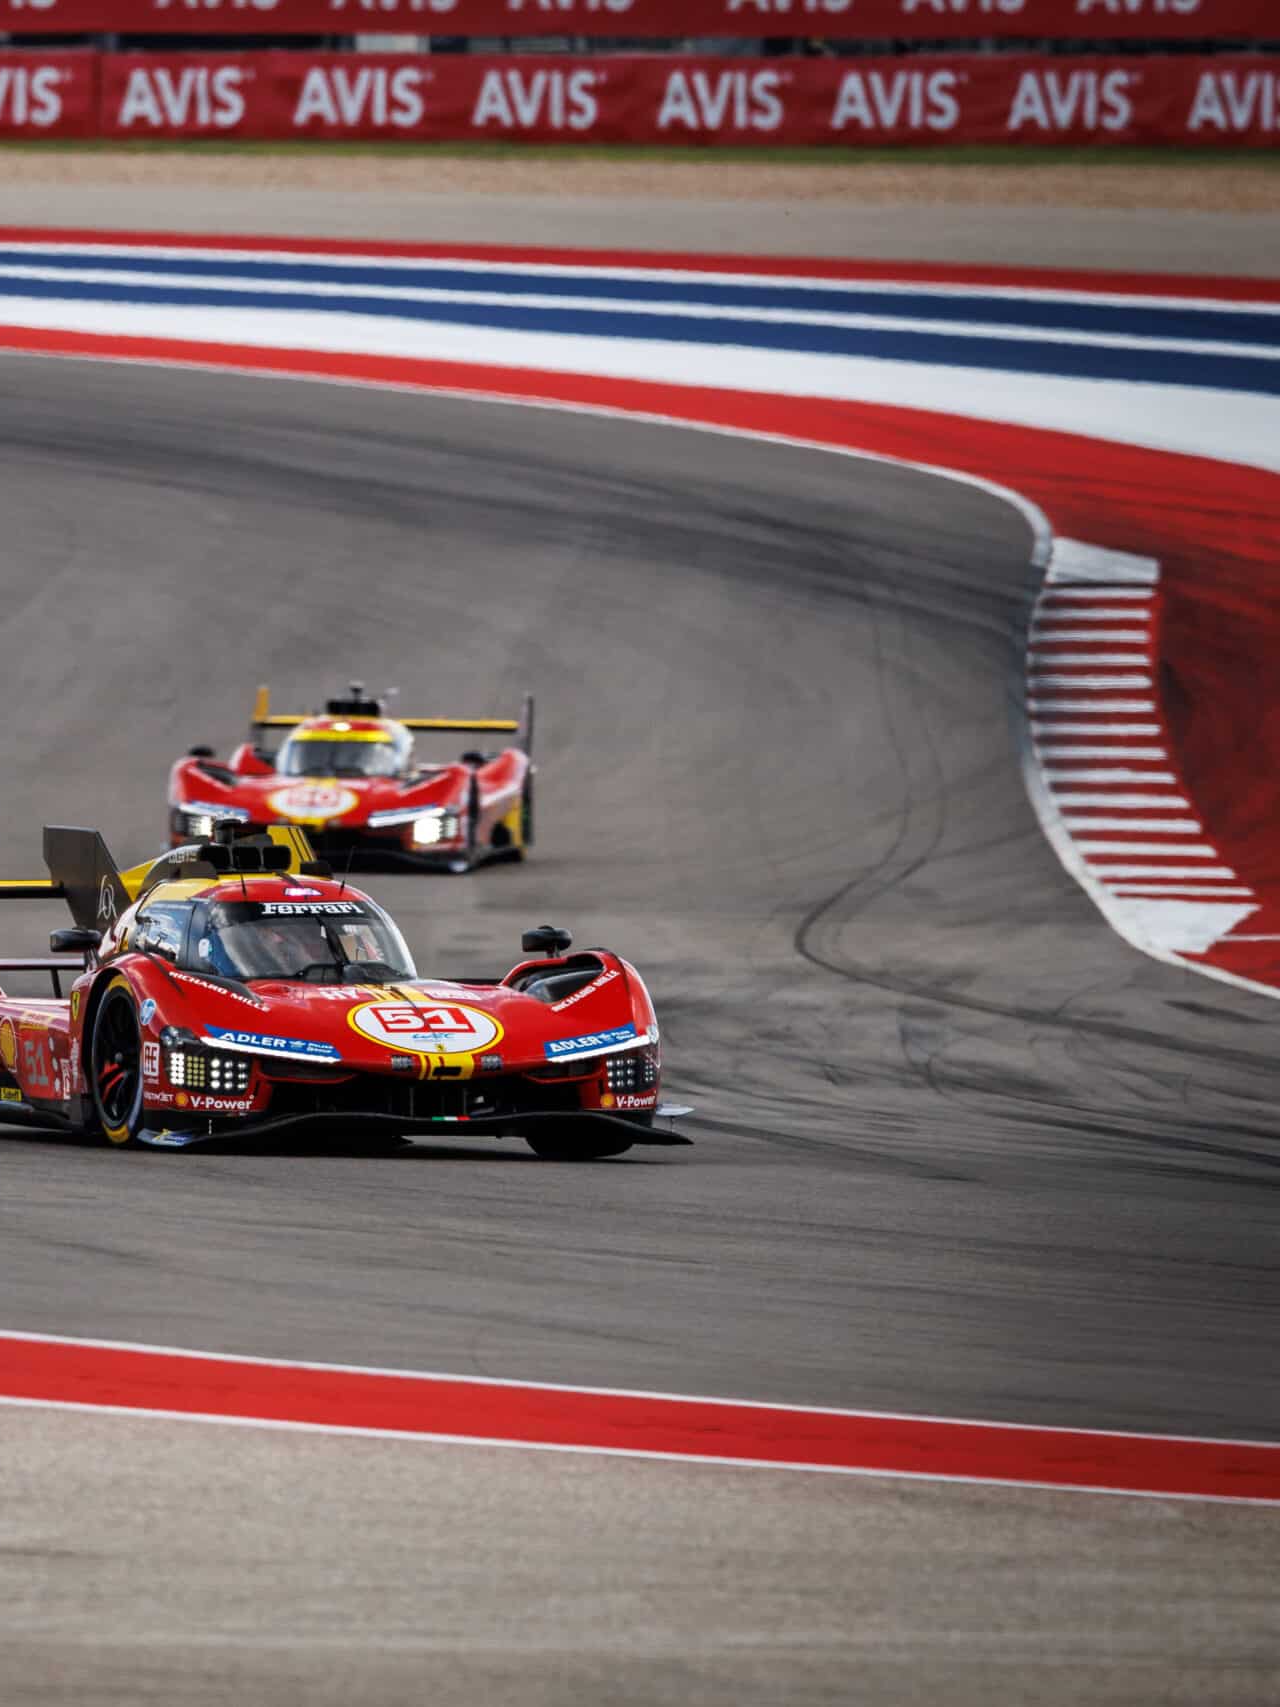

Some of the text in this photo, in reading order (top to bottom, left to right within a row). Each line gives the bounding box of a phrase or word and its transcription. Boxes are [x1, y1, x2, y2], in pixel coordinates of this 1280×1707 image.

[119, 66, 246, 128] AVIS
[293, 67, 425, 128] AVIS
[473, 70, 598, 129] AVIS
[658, 70, 783, 130] AVIS
[832, 71, 959, 130] AVIS
[1008, 69, 1131, 130] AVIS
[261, 902, 365, 914] Ferrari
[168, 971, 271, 1012] RICHARD MILLE
[377, 1008, 470, 1031] 51
[220, 1032, 286, 1048] ADLER
[549, 1036, 603, 1053] ADLER
[23, 1040, 49, 1087] 51
[190, 1095, 254, 1110] V-Power
[616, 1095, 656, 1108] V-Power
